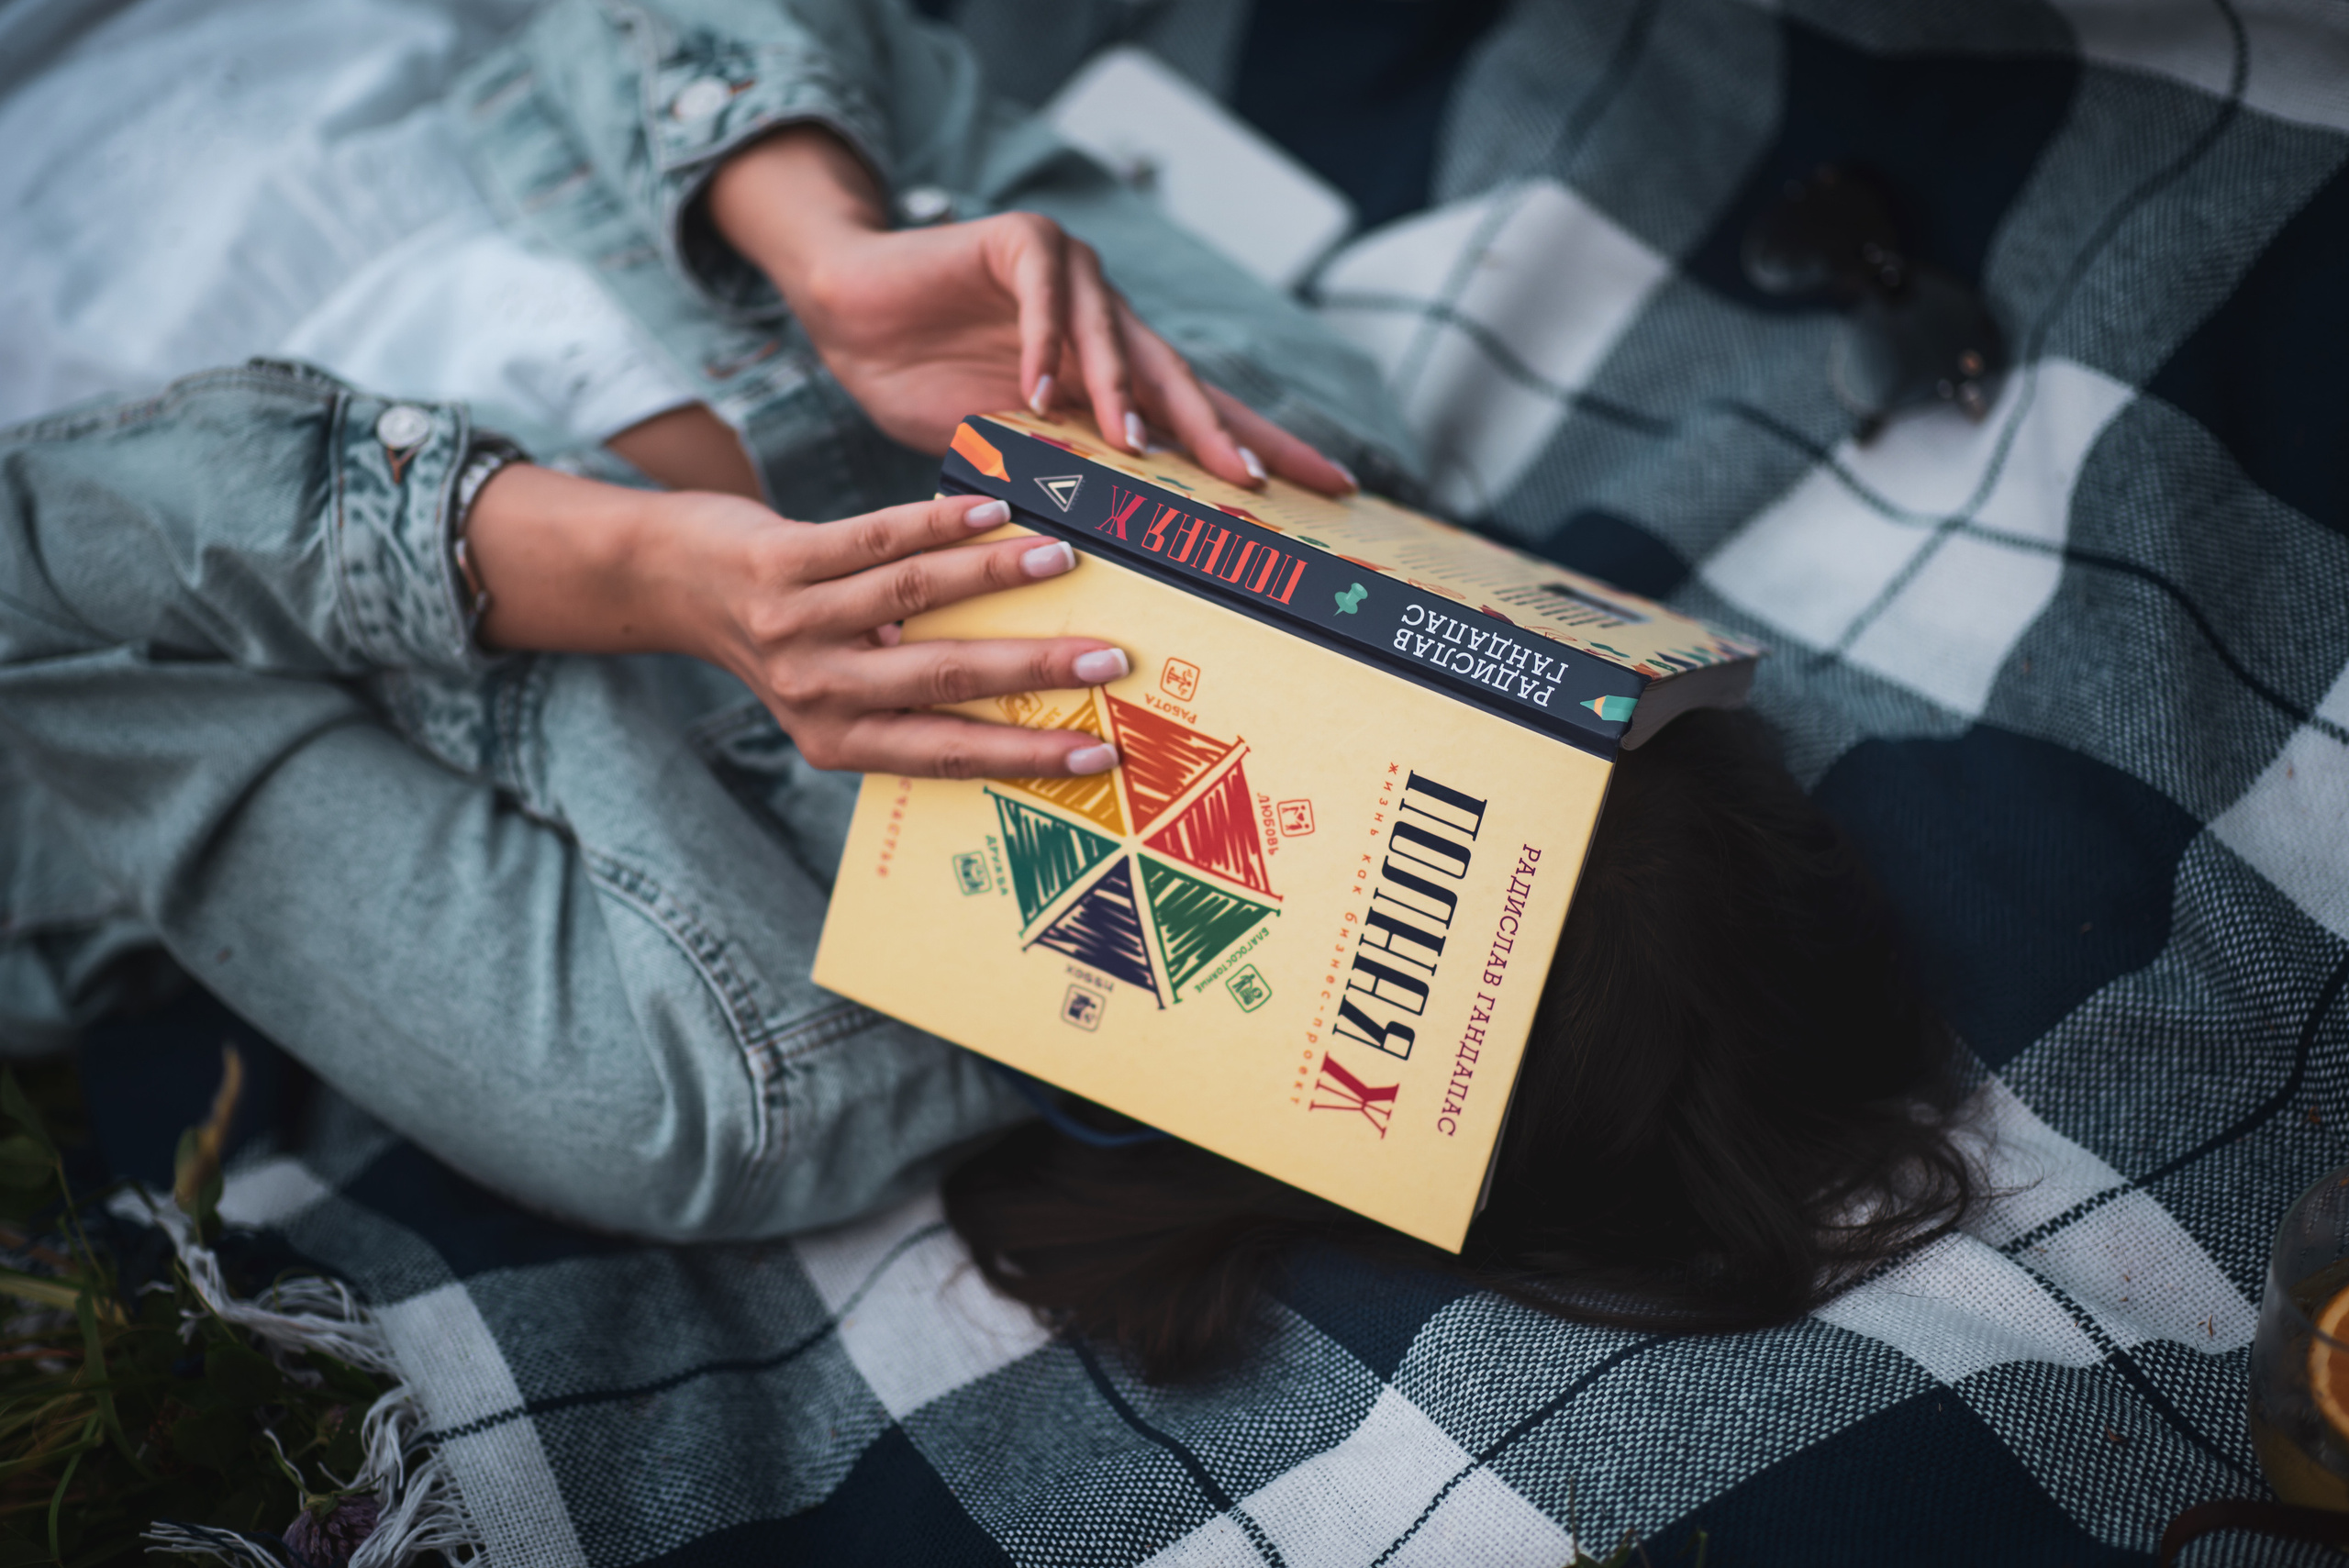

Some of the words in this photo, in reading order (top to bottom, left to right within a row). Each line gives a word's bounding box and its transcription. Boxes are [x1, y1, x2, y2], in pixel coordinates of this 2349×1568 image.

[1095, 485, 1147, 540] Ж
[1141, 504, 1308, 605] ПОЛНАЯ
[1394, 628, 1554, 706] РАДИСЛАВ
[1401, 605, 1568, 684] ГАНДАПАС
[1145, 694, 1197, 724] РАБОТА
[1257, 793, 1278, 855] ЛЮБОВЬ
[1370, 762, 1398, 836] жизнь
[985, 835, 1008, 895] ДРУЖБА
[1353, 854, 1371, 895] как
[1332, 770, 1487, 1061] ПОЛНАЯ
[1484, 844, 1542, 985] РАДИСЛАВ
[1195, 928, 1269, 993] БЛАГОСОСТОЯНИЕ
[1291, 912, 1357, 1104] бизнес-проект
[1309, 1052, 1399, 1139] Ж
[1438, 992, 1495, 1136] ГАНДАПАС
